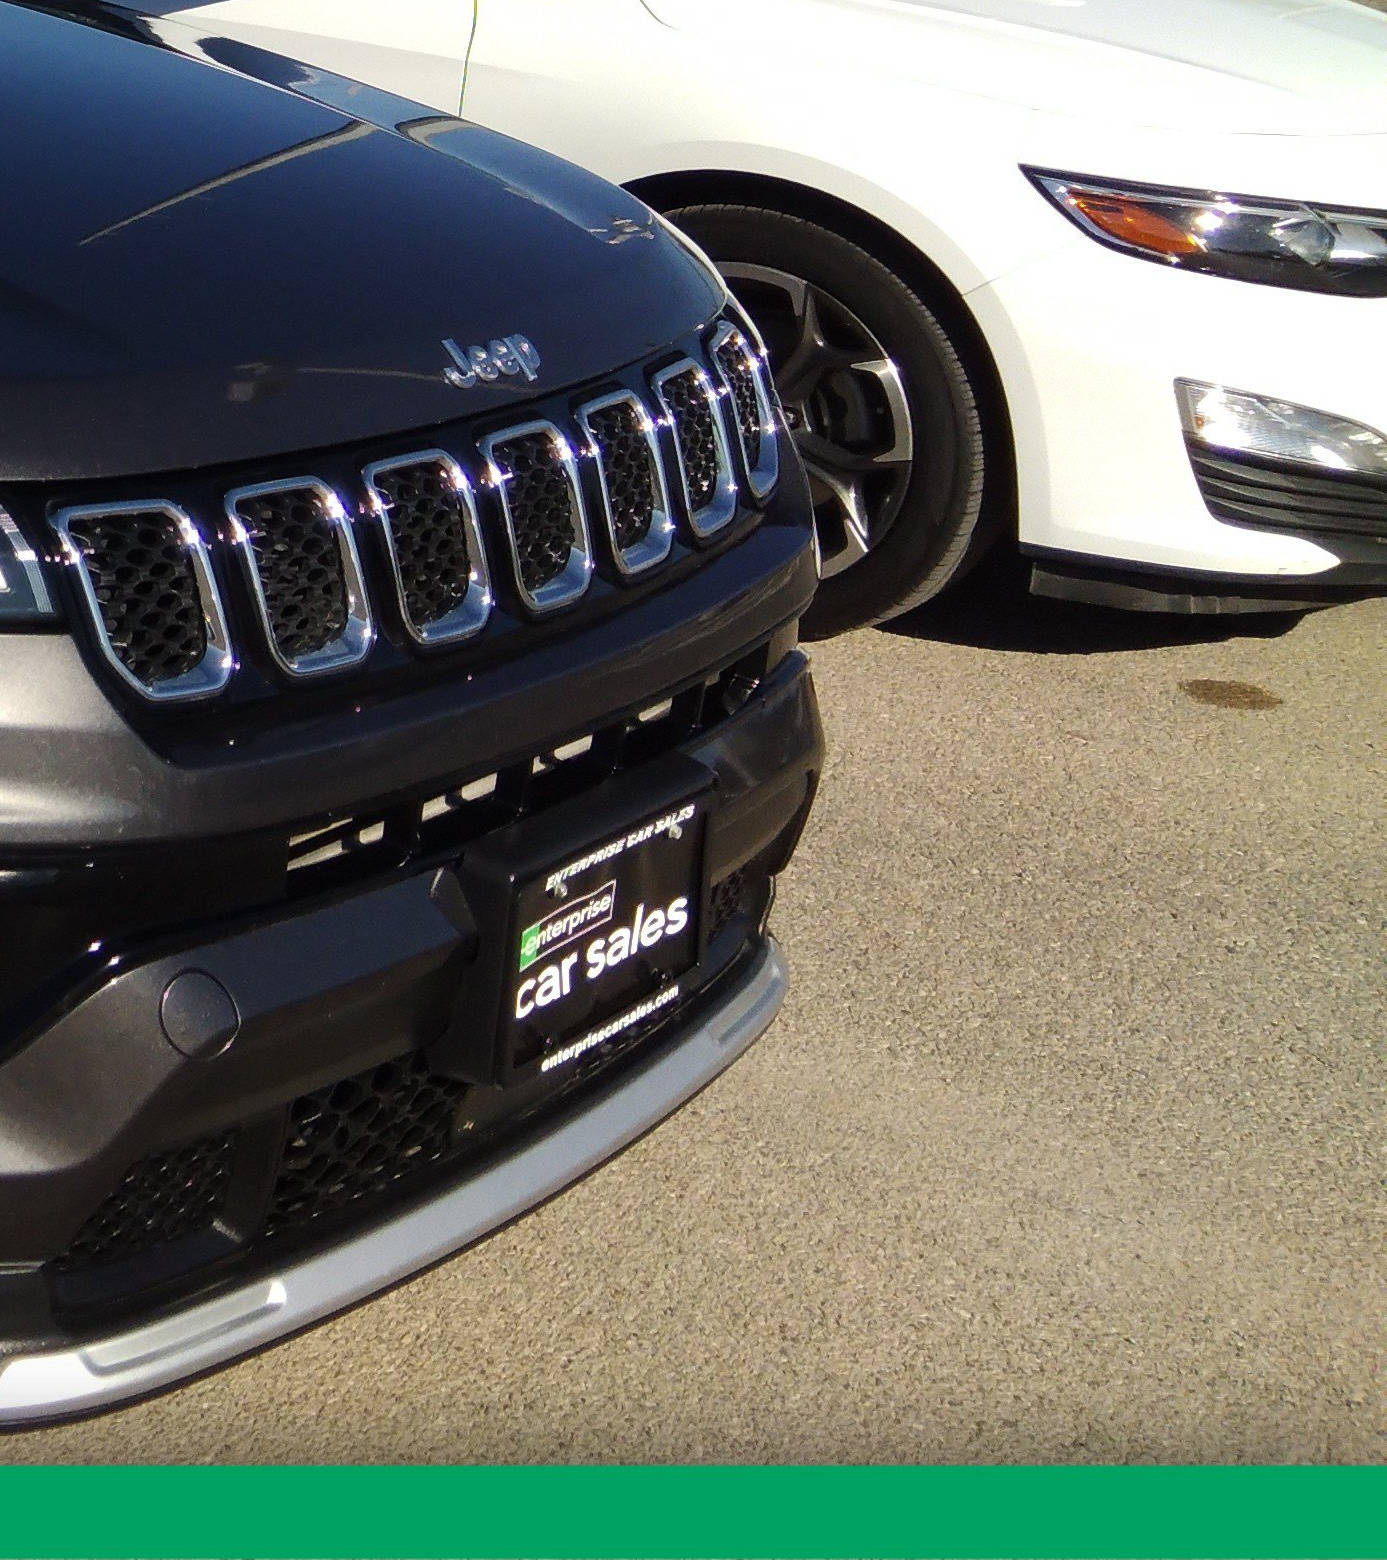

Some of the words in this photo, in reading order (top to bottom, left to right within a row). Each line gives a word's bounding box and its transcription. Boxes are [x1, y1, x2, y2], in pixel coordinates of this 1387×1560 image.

[441, 334, 540, 389] Jeep
[545, 837, 627, 892] ENTERPRISE
[627, 823, 654, 849] CAR
[655, 804, 696, 834] SALES
[515, 951, 578, 1020] car
[586, 896, 688, 979] sales
[521, 893, 612, 956] enterprise
[541, 985, 679, 1073] enterprisecarsales.com
